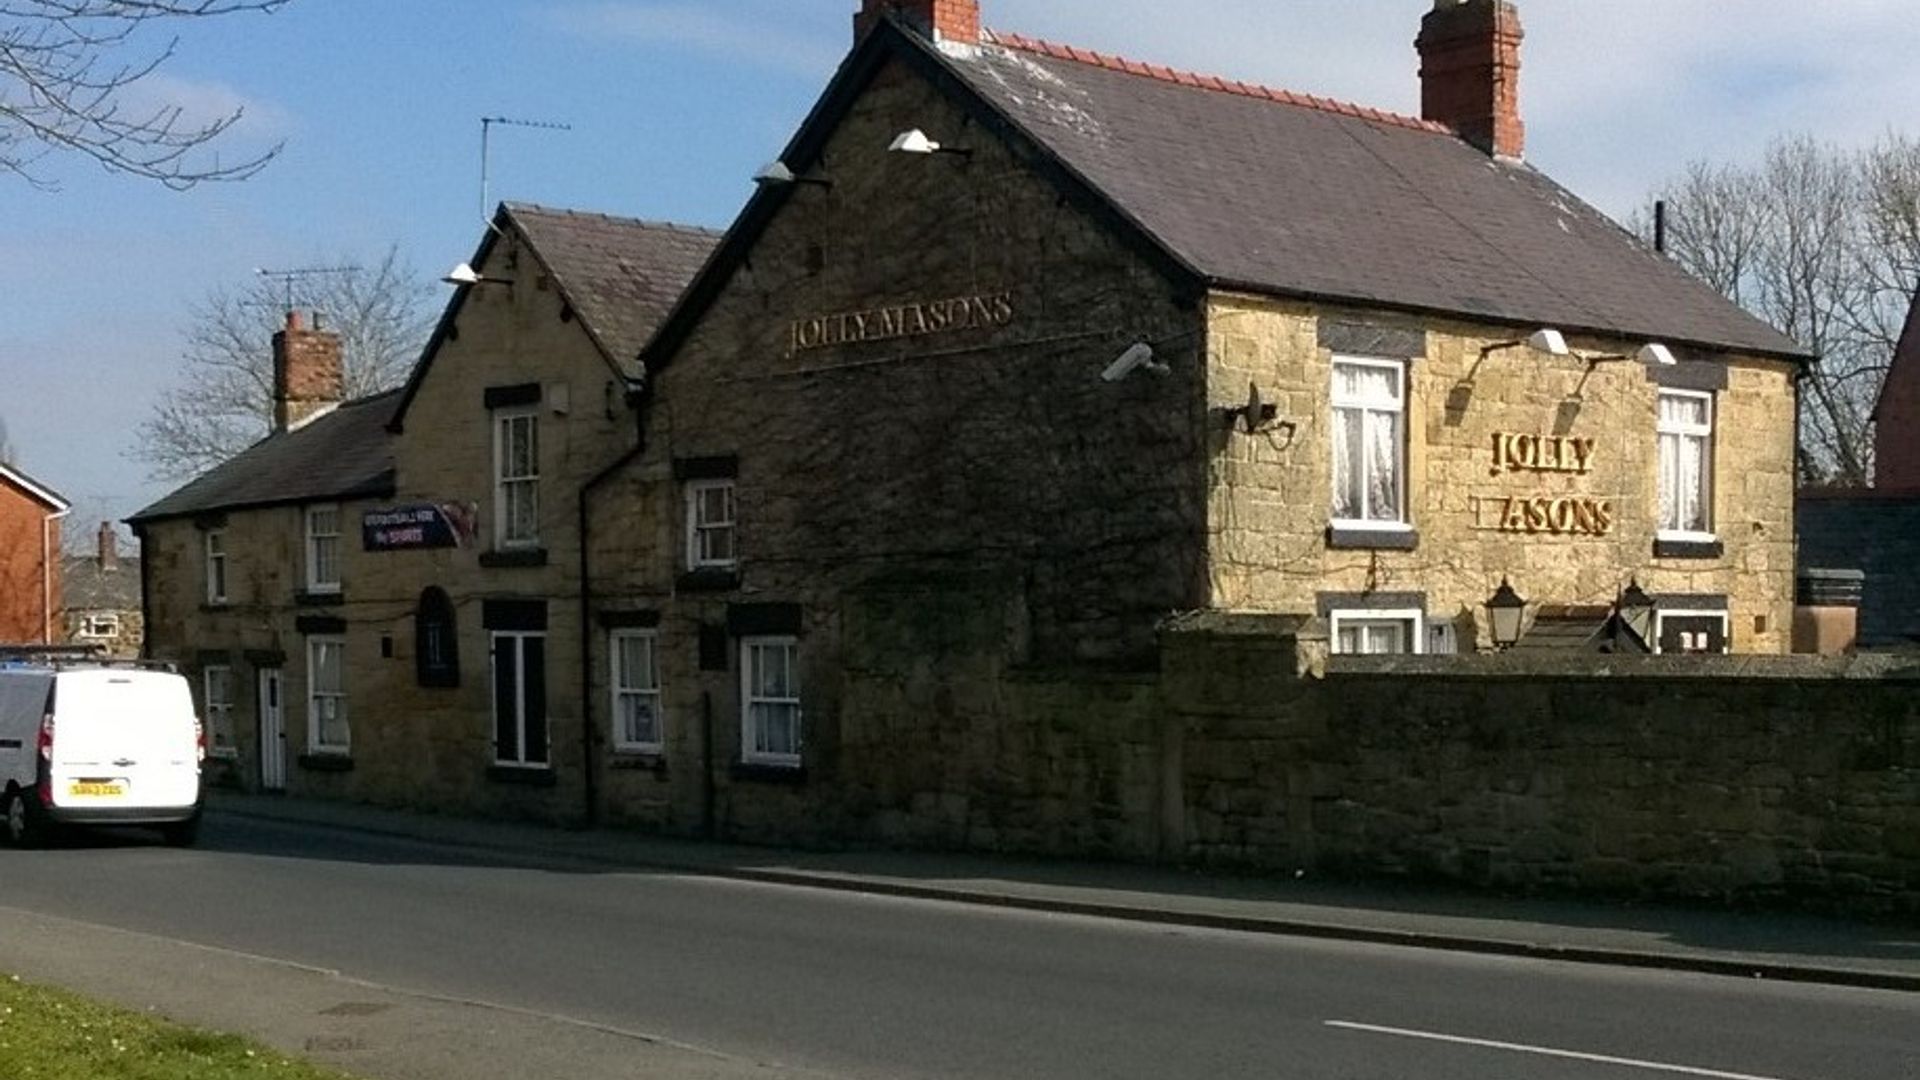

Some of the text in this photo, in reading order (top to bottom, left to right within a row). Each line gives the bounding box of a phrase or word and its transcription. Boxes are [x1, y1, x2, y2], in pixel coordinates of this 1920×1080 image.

[785, 293, 1012, 359] JOLLY MASONS
[1490, 433, 1598, 475] JOLLY
